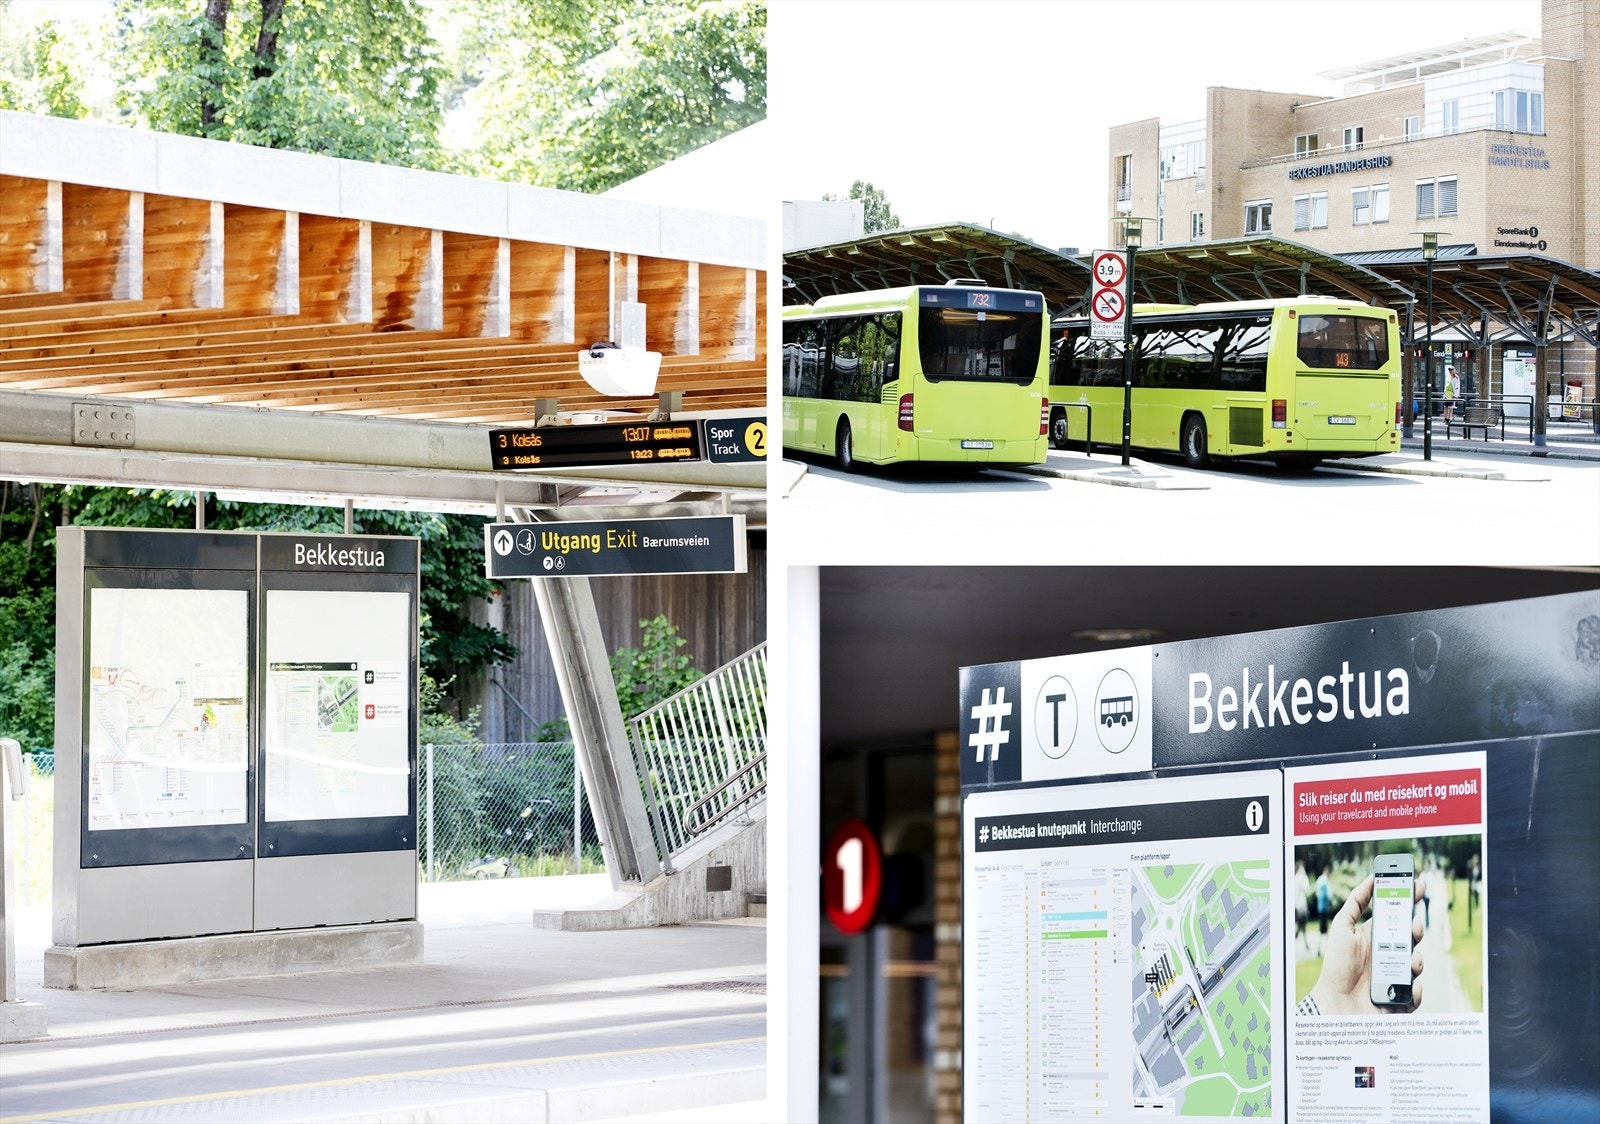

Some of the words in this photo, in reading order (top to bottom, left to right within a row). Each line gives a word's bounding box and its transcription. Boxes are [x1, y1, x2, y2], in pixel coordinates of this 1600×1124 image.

[1491, 144, 1546, 157] BEKKESTUA
[1288, 163, 1333, 181] BEKKESTUA
[1334, 155, 1391, 174] HANDELSHUS
[1488, 156, 1550, 170] HANDELSHUS
[1099, 265, 1114, 276] 3,9
[972, 293, 990, 306] 732
[1336, 353, 1349, 367] 143
[499, 434, 507, 448] 3
[512, 433, 543, 448] Kolsås
[622, 427, 651, 442] 13:07
[710, 427, 734, 440] Spor
[753, 428, 764, 450] 2
[502, 456, 509, 465] 3
[514, 454, 541, 465] Kolsås
[630, 449, 653, 459] 13:23
[713, 443, 740, 455] Track
[541, 531, 601, 555] Utgang
[606, 529, 637, 549] Exit
[642, 535, 710, 548] Bærumsveien
[295, 542, 385, 567] Bekkestua
[1188, 660, 1410, 735] Bekkestua
[1299, 792, 1318, 807] Slik
[1319, 790, 1349, 806] reiser
[1350, 789, 1362, 804] du
[1364, 787, 1386, 802] med
[1387, 784, 1433, 801] reisekort
[1434, 785, 1447, 800] og
[1449, 779, 1478, 796] mobil
[1299, 811, 1320, 825] Using
[1320, 811, 1336, 825] your
[1337, 807, 1373, 821] travelcard
[1374, 806, 1387, 818] and
[1389, 804, 1413, 818] mobile
[1414, 804, 1438, 818] phone
[991, 823, 1036, 841] Bekkestua
[1037, 820, 1087, 839] knutepunkt
[1090, 817, 1142, 834] Interchange
[836, 837, 863, 915] 1
